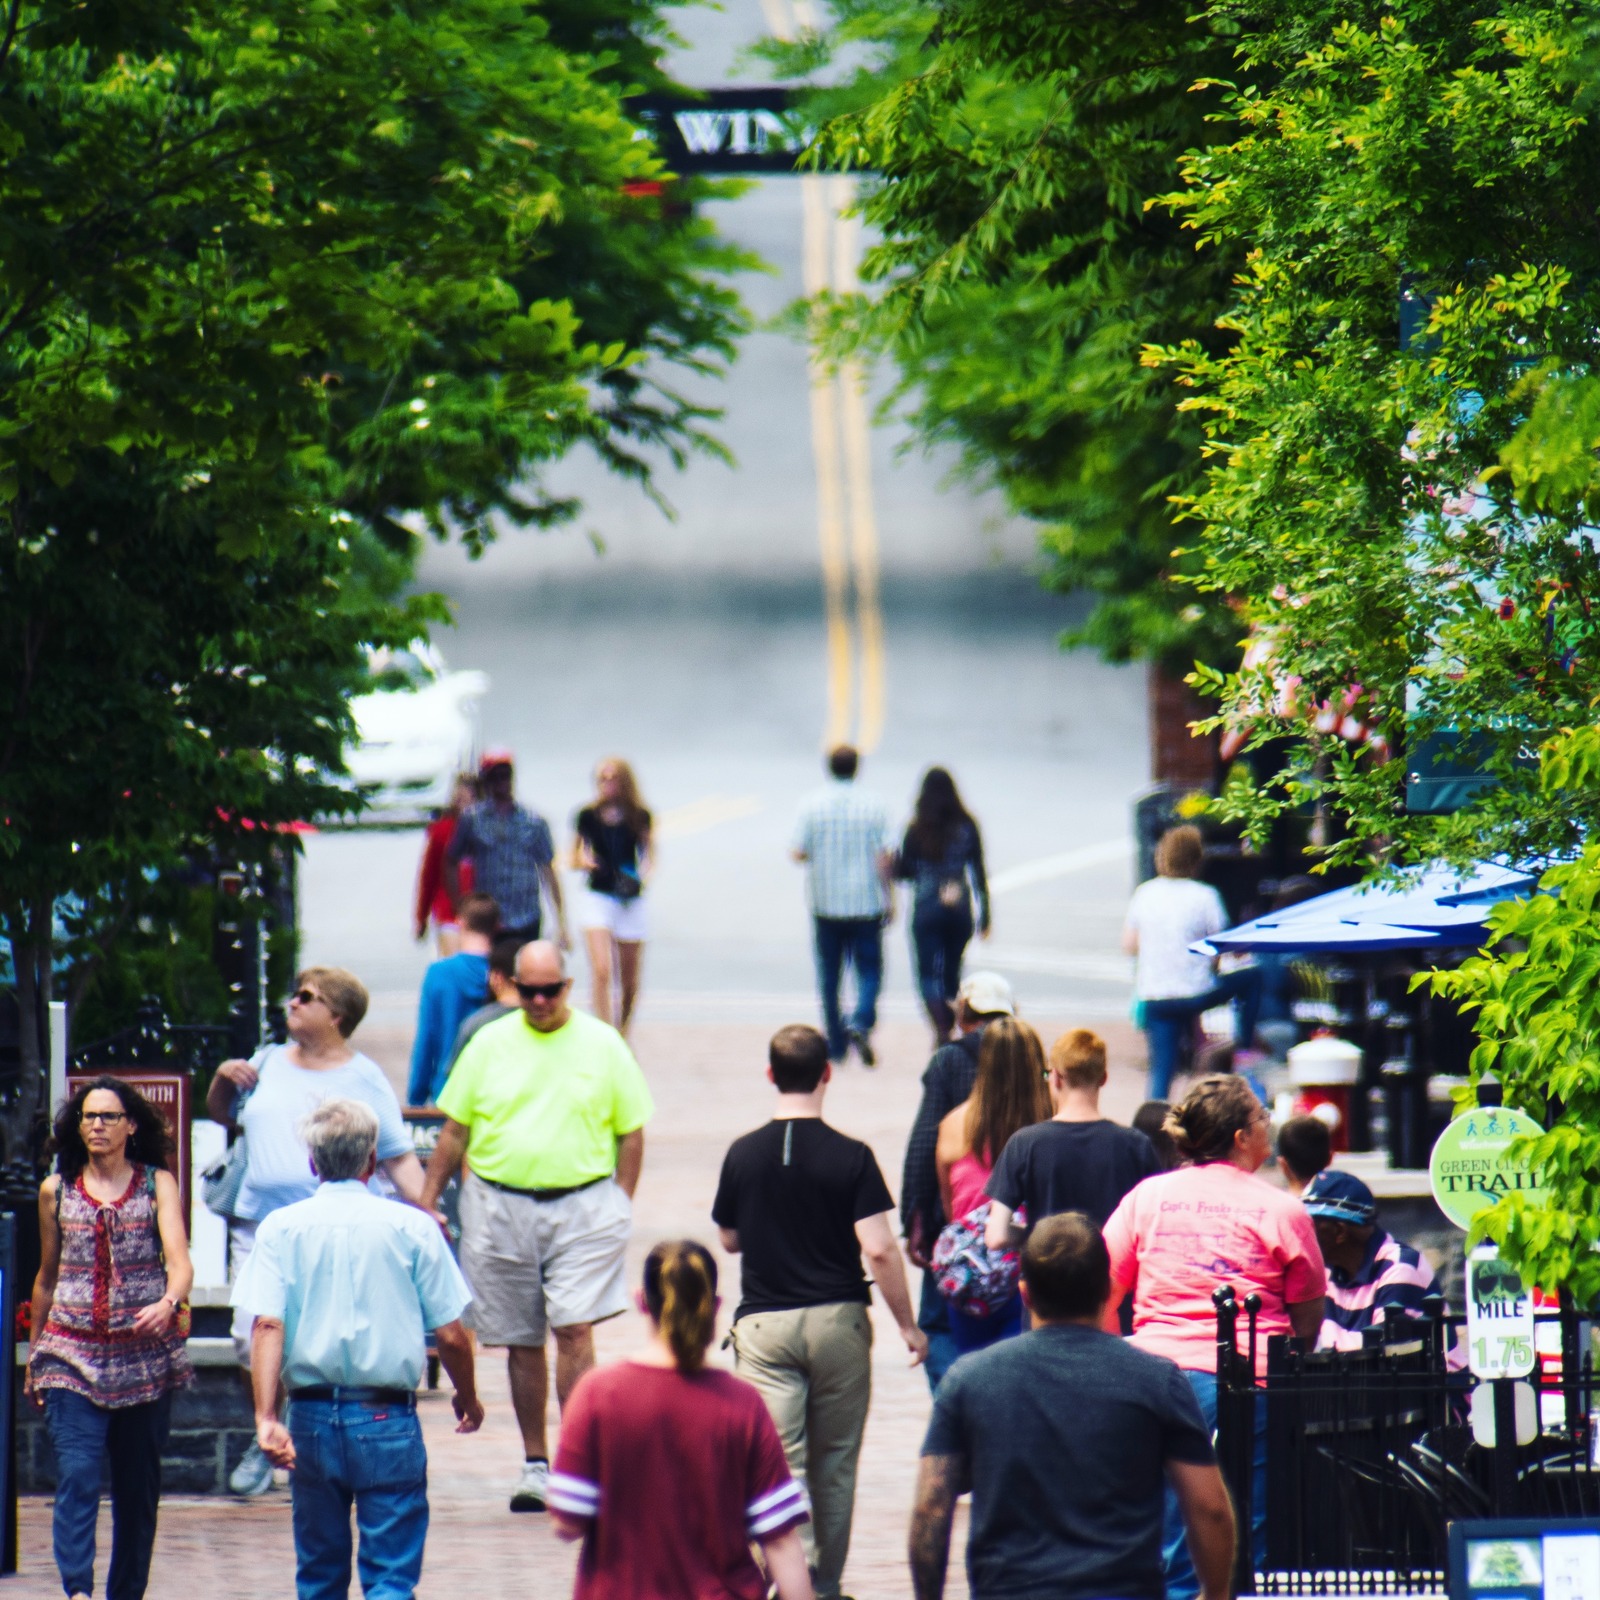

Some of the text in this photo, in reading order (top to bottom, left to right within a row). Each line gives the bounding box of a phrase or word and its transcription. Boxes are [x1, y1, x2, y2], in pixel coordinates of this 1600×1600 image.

[1440, 1159, 1491, 1174] GREEN
[1477, 1297, 1524, 1319] MILE
[1472, 1336, 1533, 1369] 1.75
